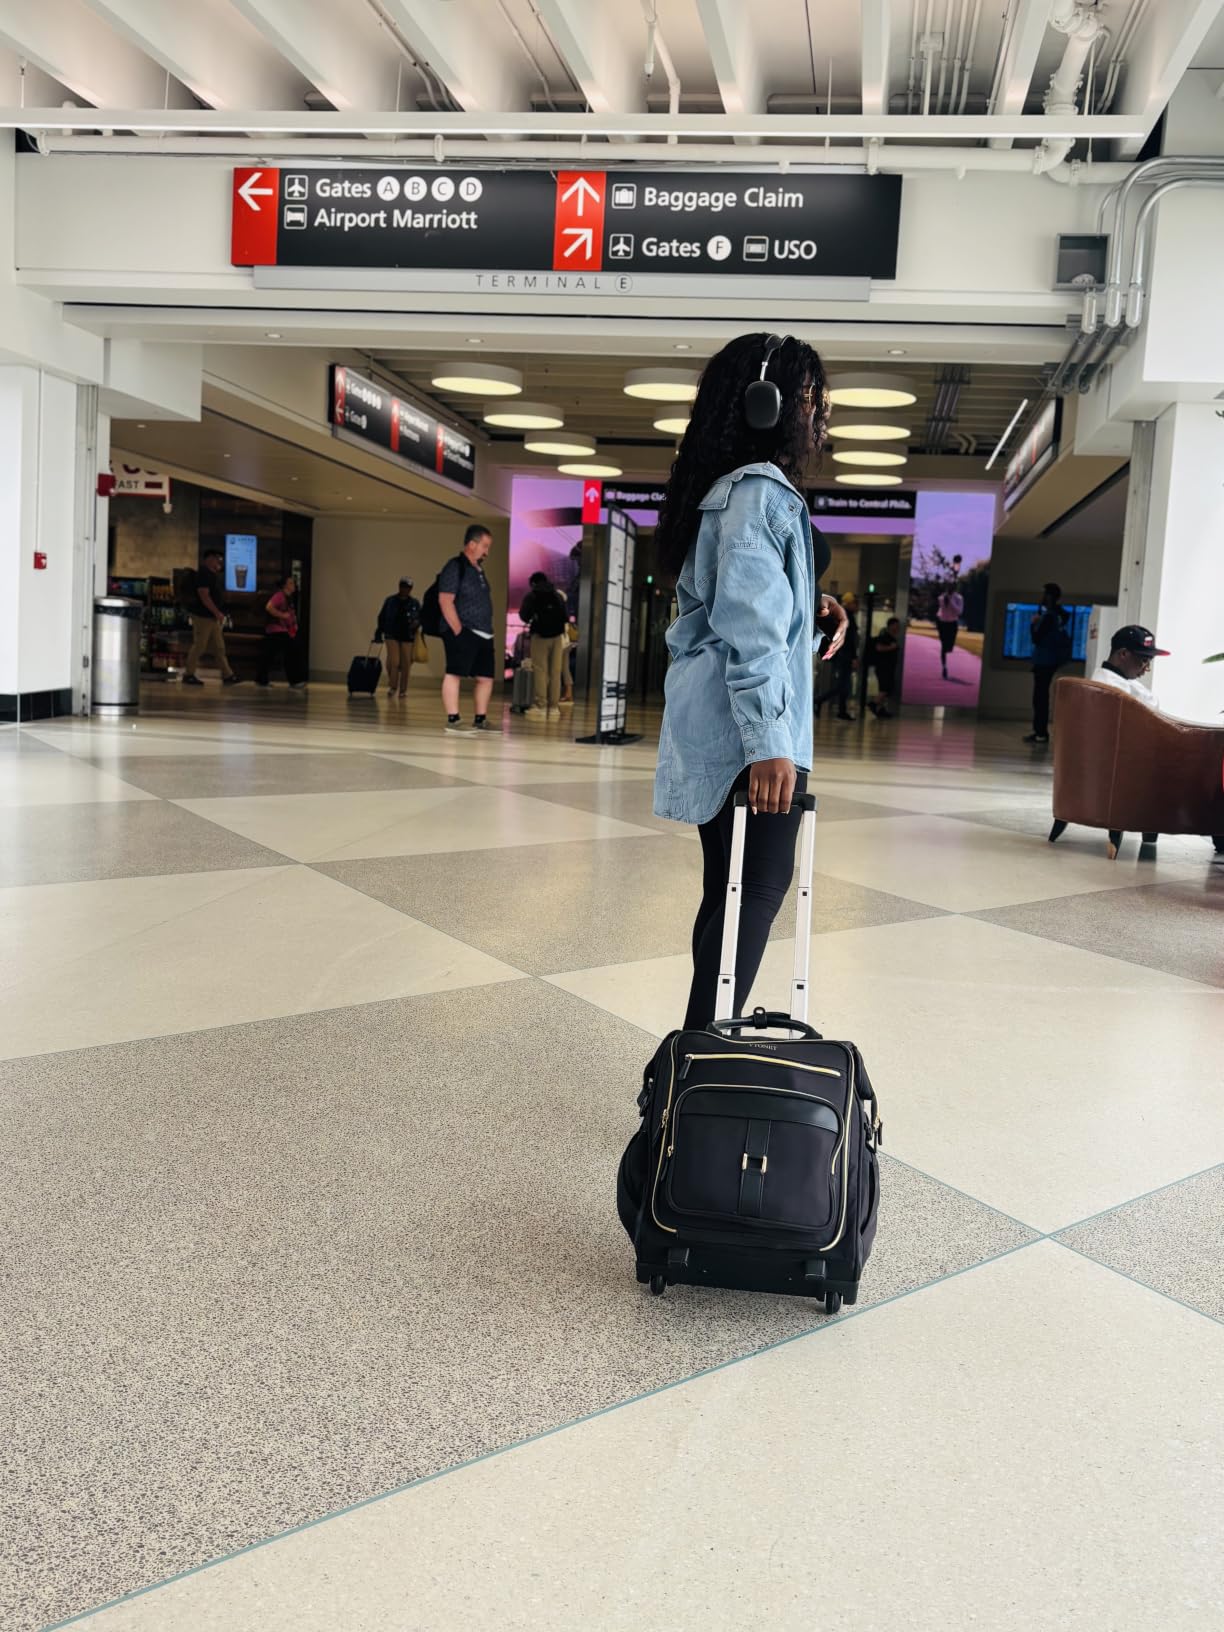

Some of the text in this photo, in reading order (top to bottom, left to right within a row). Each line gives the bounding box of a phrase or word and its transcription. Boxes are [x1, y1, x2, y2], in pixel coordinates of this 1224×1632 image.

[315, 178, 371, 199] Gates
[643, 187, 804, 212] Baggage Claim
[314, 208, 478, 232] Airport Marriott
[641, 237, 701, 258] Gates
[773, 240, 818, 260] USO
[476, 274, 601, 290] TERMINAL
[117, 480, 139, 489] AST
[616, 491, 650, 502] Baggage
